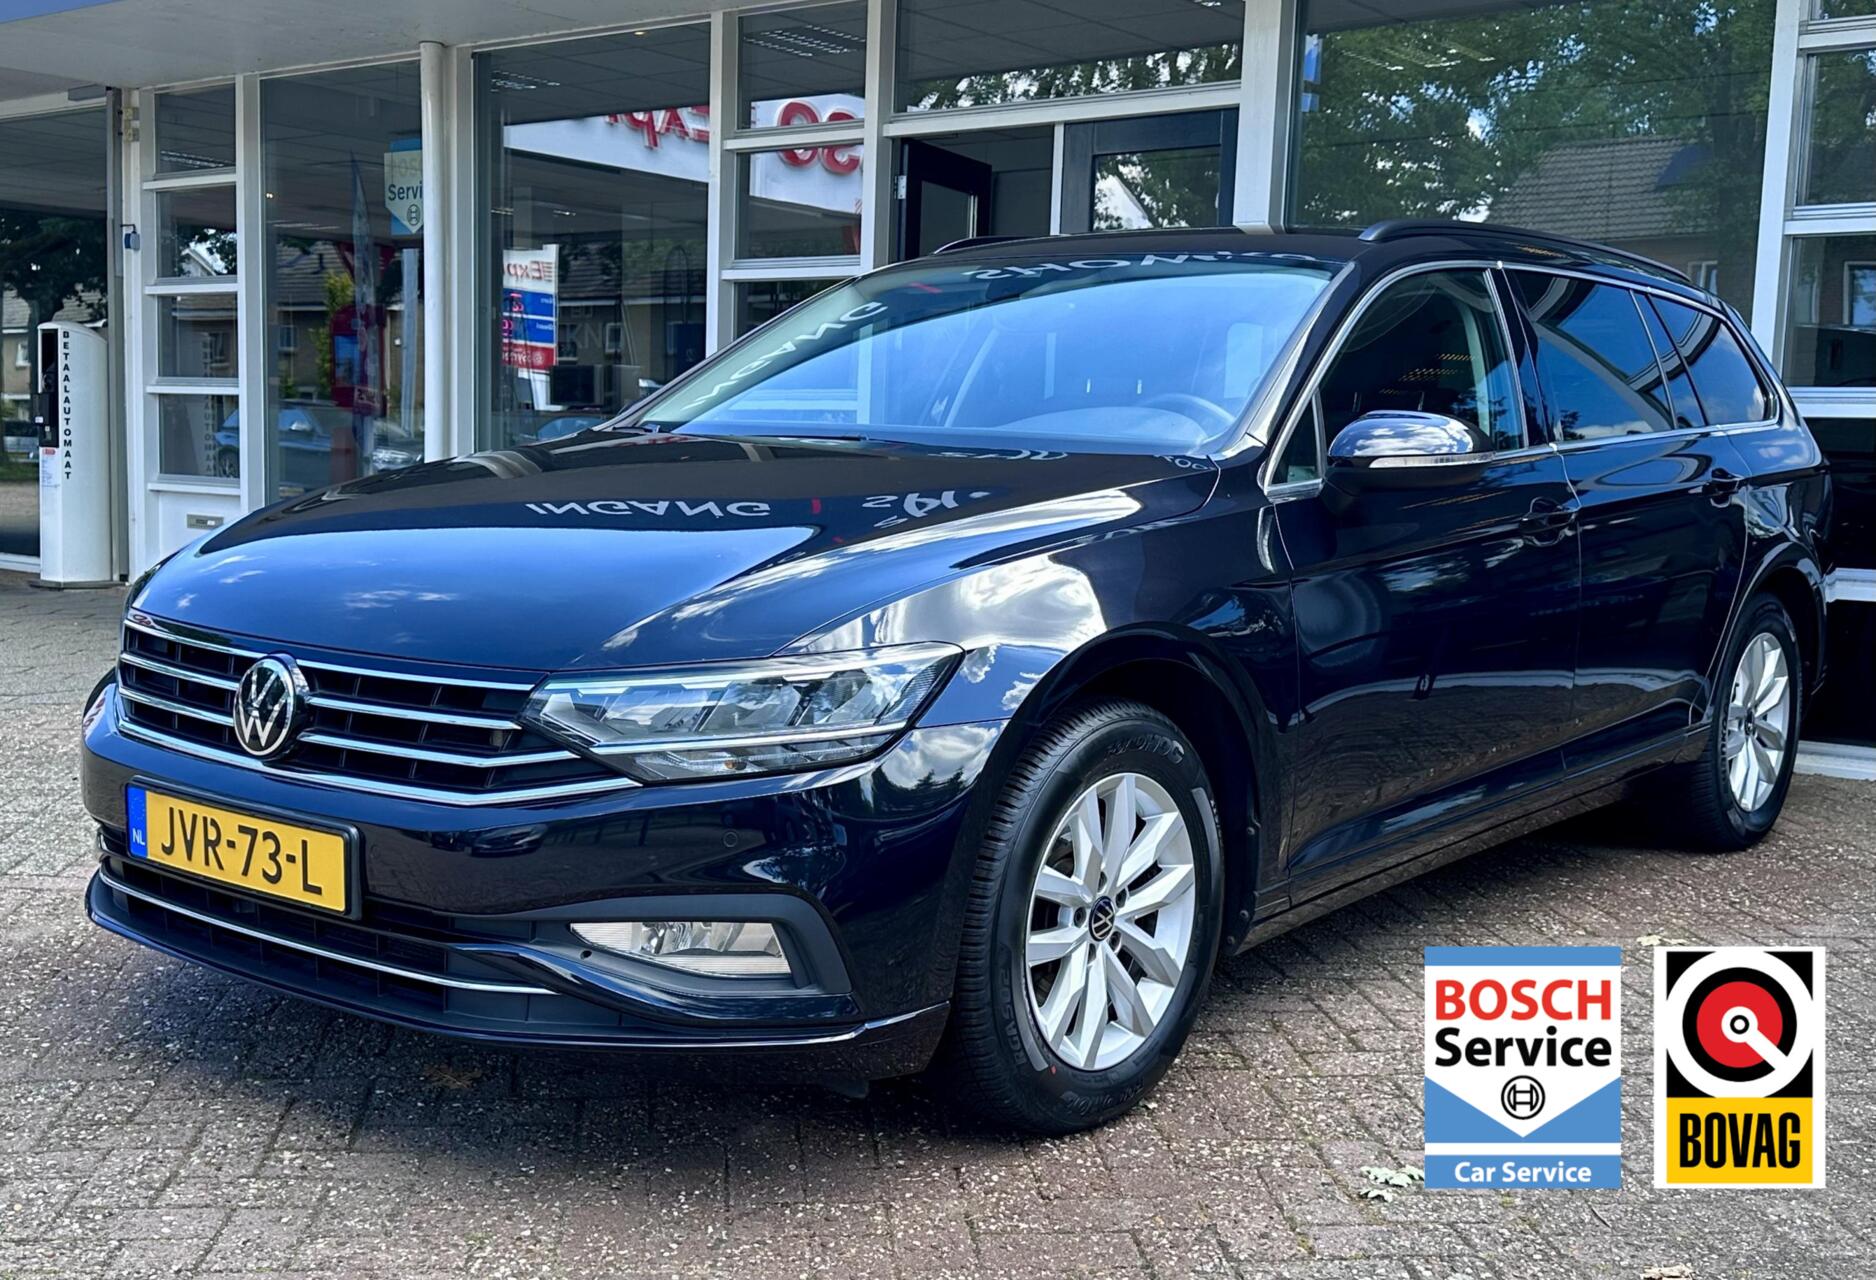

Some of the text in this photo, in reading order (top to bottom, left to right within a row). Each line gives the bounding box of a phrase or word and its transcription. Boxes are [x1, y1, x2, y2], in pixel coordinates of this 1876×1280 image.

[62, 331, 72, 479] BETAALAUTOMAAT
[132, 827, 145, 846] NL
[161, 806, 322, 896] JVR-73-L
